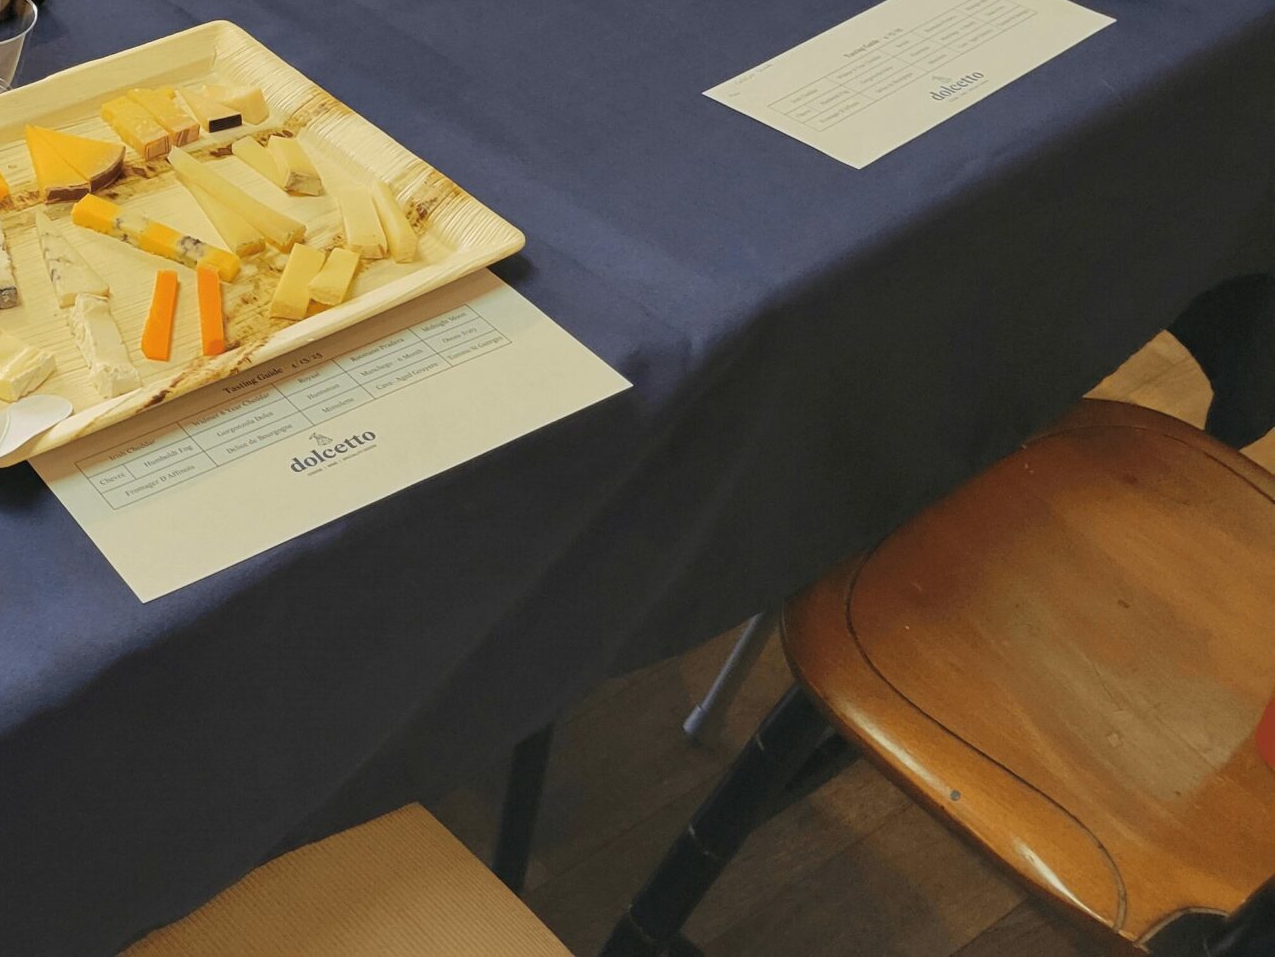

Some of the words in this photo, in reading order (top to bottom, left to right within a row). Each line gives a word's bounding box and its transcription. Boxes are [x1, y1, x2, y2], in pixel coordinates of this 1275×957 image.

[929, 72, 985, 101] dolcetto
[222, 377, 257, 395] Tasting
[256, 366, 284, 386] Guide
[242, 391, 270, 408] Cheddar
[125, 439, 156, 455] Cheddar
[290, 431, 376, 473] dolcetto
